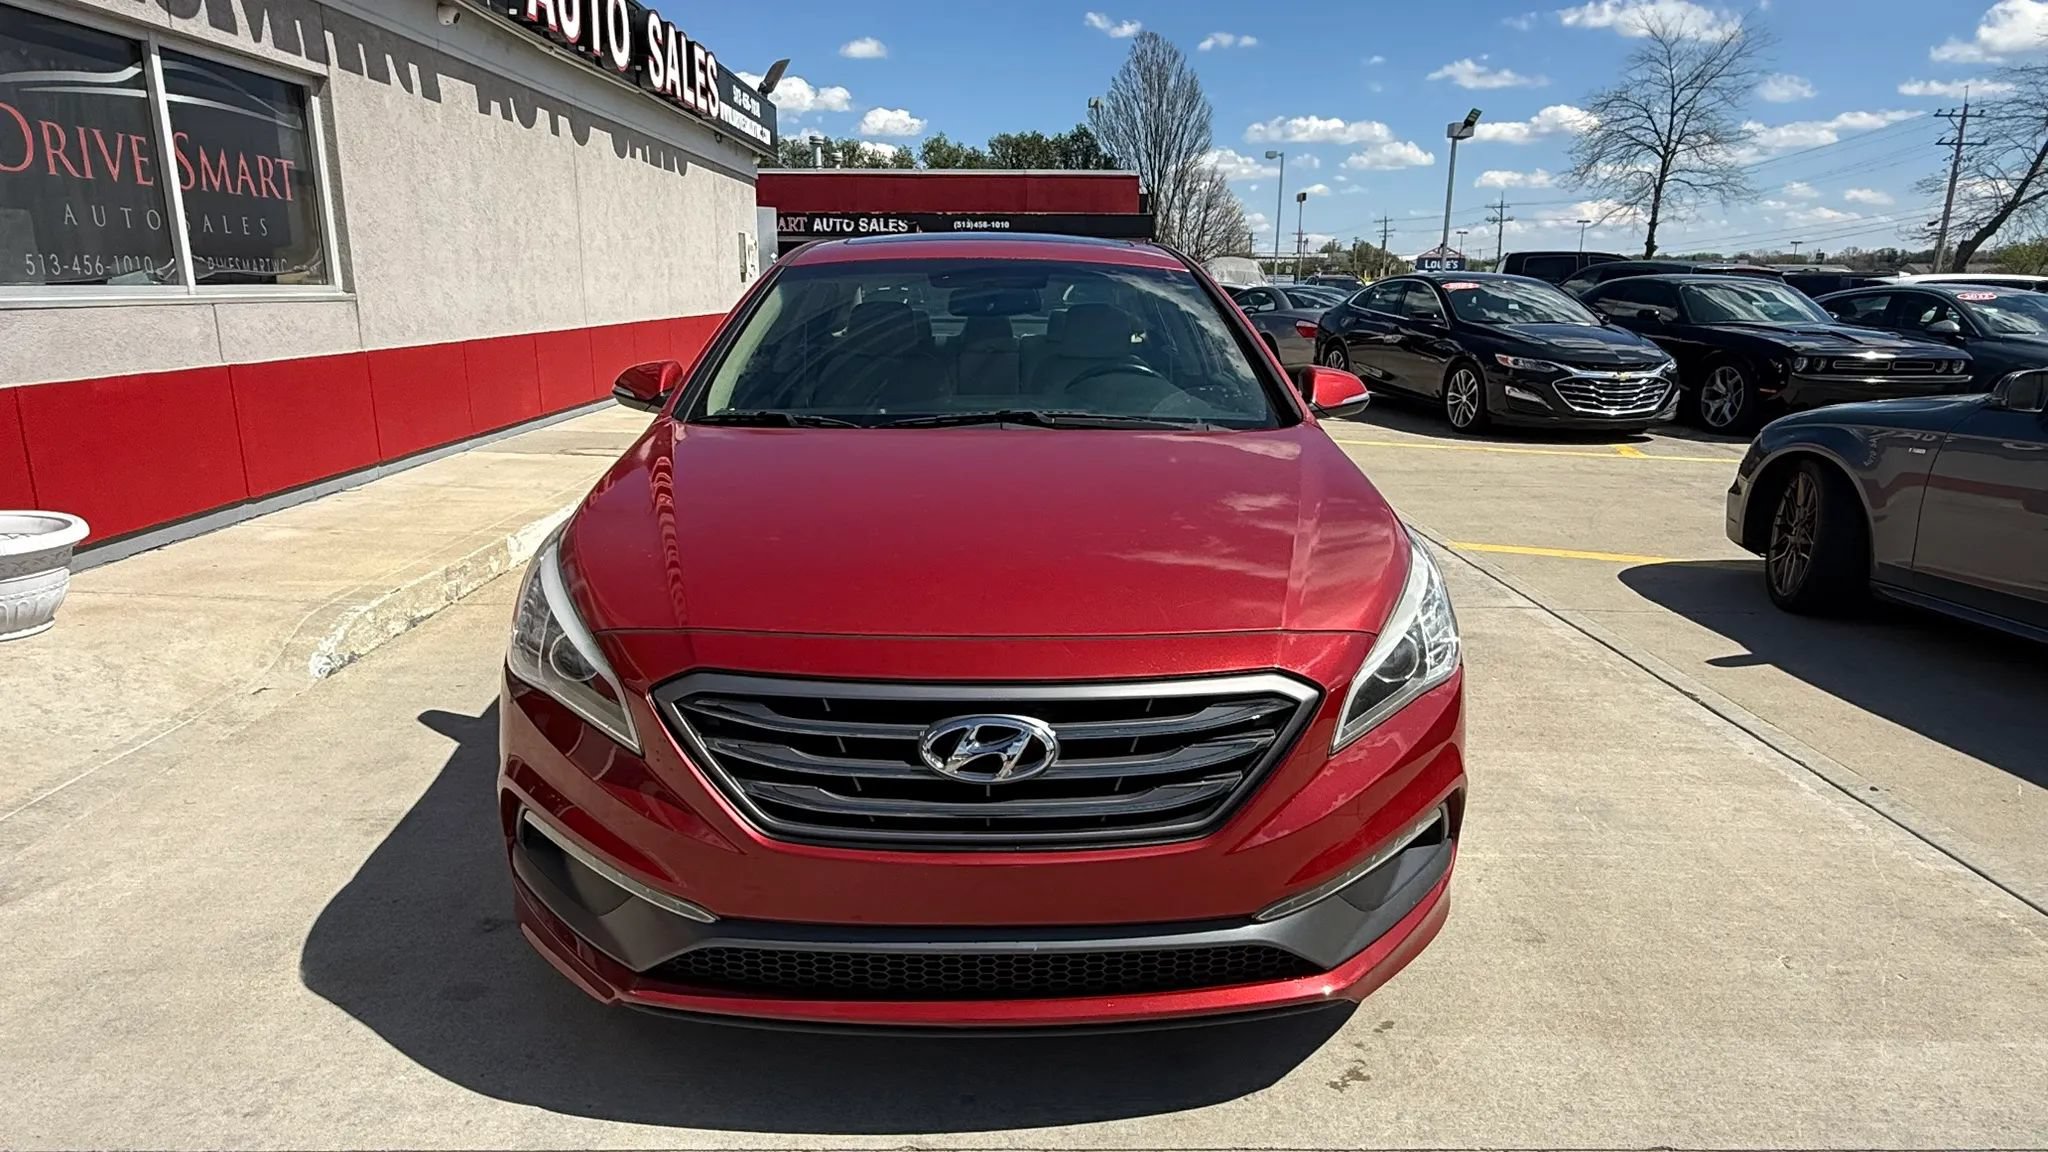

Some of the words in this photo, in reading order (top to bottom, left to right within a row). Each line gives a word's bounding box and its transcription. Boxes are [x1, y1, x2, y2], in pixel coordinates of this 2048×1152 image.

[648, 10, 720, 118] SALES
[0, 103, 154, 186] DRIVE
[172, 131, 295, 201] SMART
[63, 203, 162, 231] AUTO
[813, 217, 855, 232] AUTO
[858, 217, 909, 232] SALES
[25, 253, 155, 275] 513-456-1010
